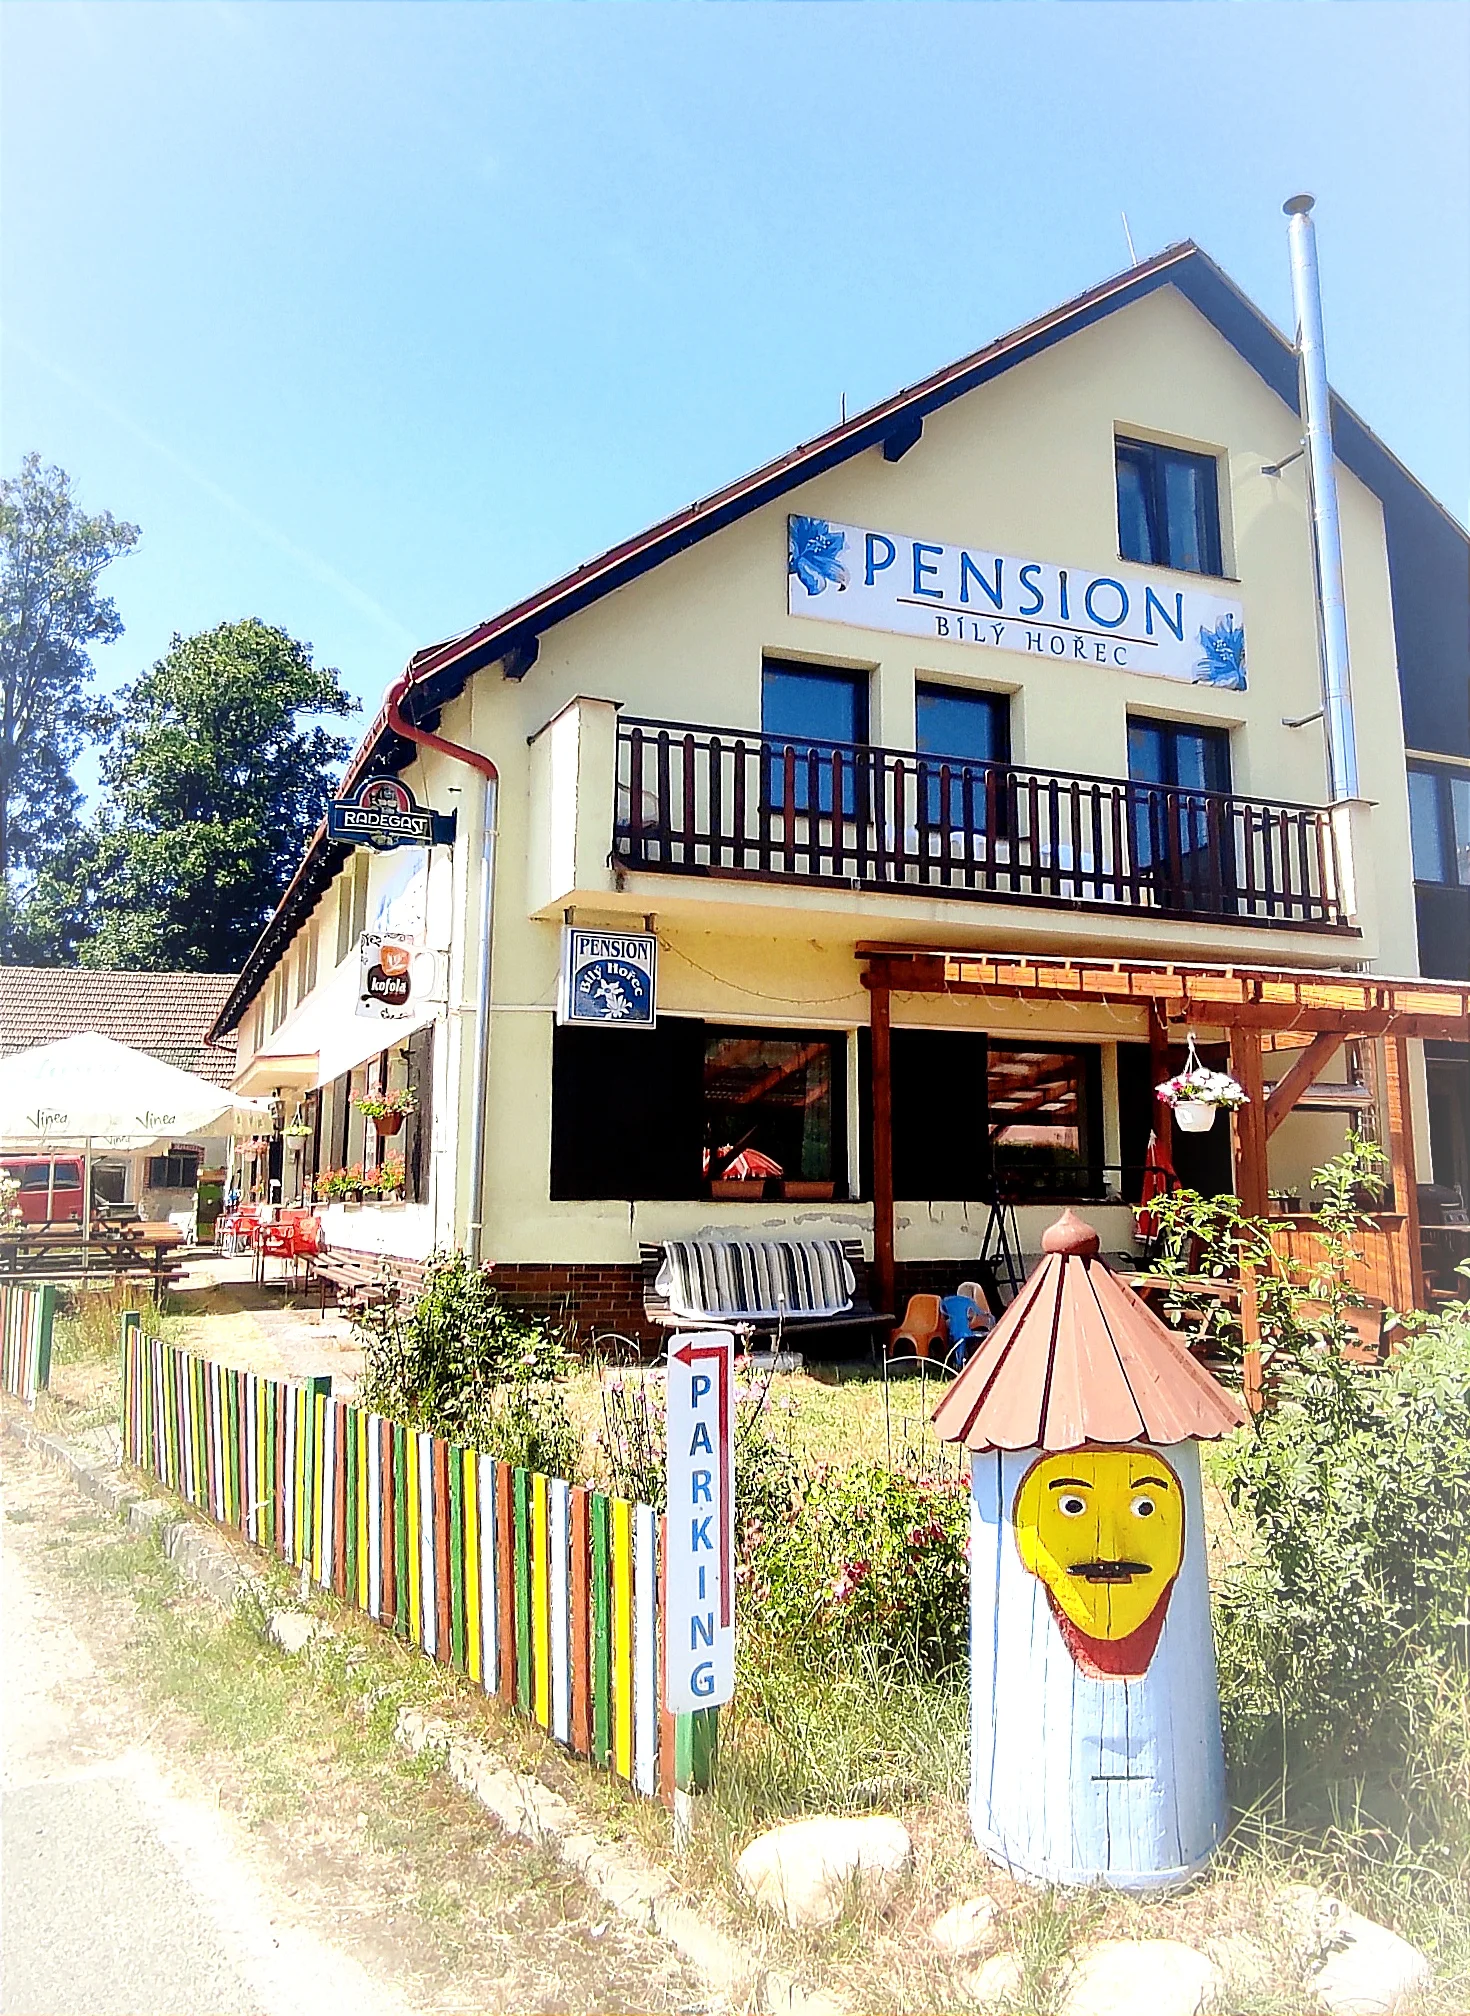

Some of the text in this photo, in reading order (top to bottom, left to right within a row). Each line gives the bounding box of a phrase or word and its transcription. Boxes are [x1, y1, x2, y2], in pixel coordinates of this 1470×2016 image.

[863, 532, 1184, 642] PENSION
[935, 615, 1129, 667] BÍLÝ HOŘEC
[344, 811, 428, 834] RADEGAST
[579, 937, 648, 960] PENSION
[607, 962, 643, 996] Hořec
[26, 1109, 68, 1129] Vinea
[135, 1110, 176, 1129] Vinea
[689, 1375, 714, 1697] PARKING
